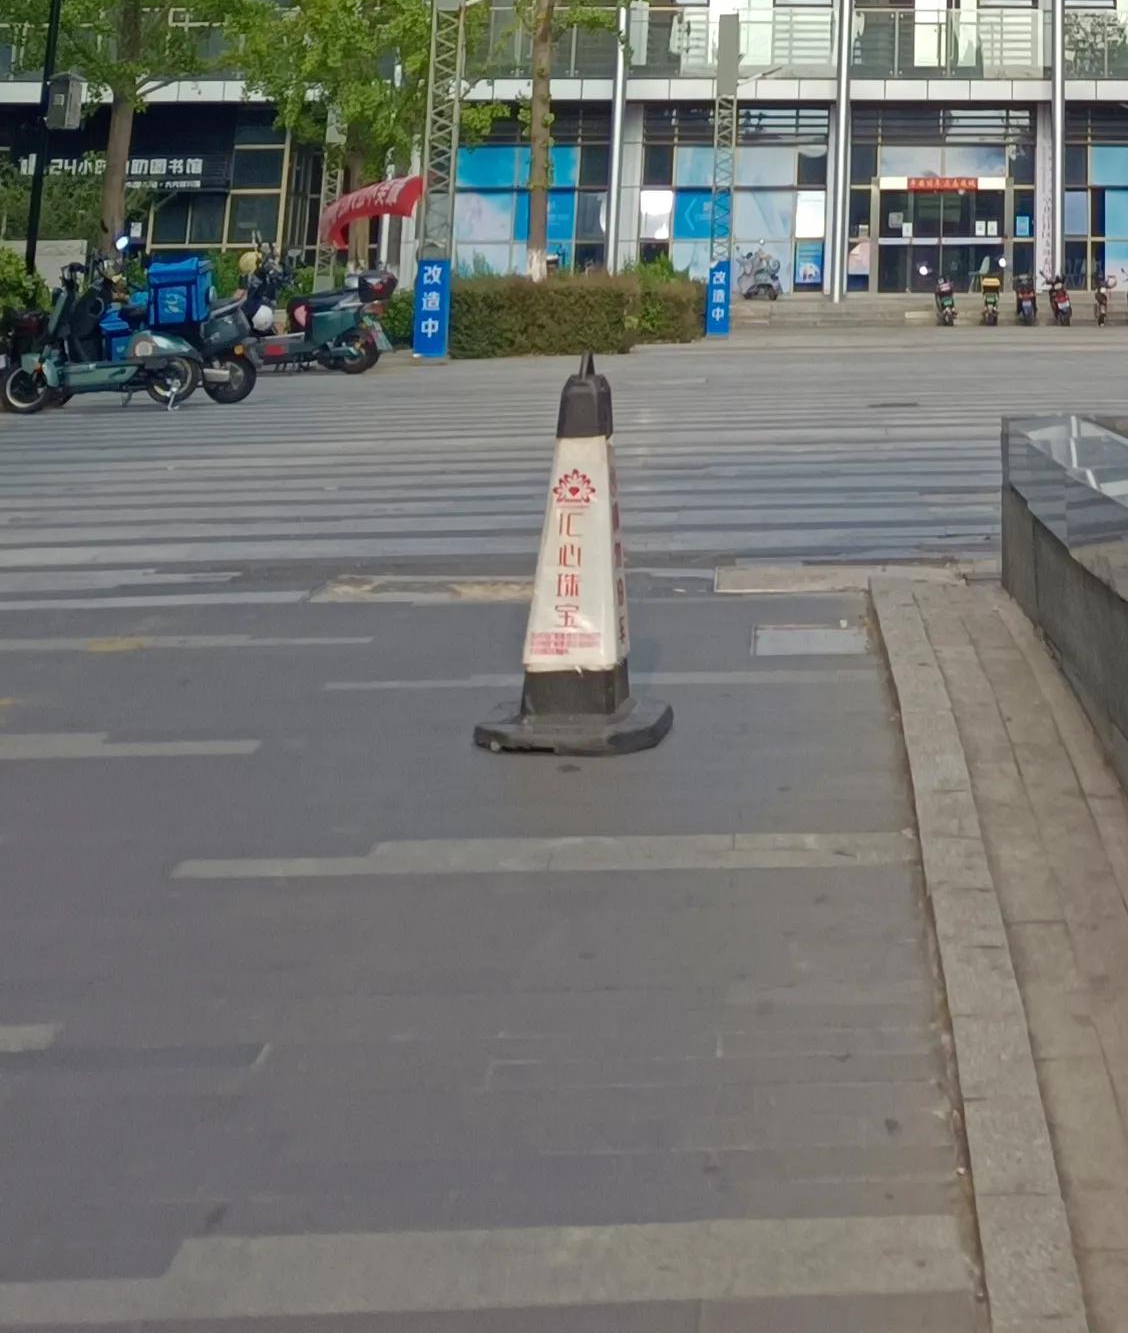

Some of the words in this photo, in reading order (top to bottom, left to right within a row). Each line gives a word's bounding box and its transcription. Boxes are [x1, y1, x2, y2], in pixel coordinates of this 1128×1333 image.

[421, 264, 442, 338] 改造中
[712, 270, 726, 321] 改造中
